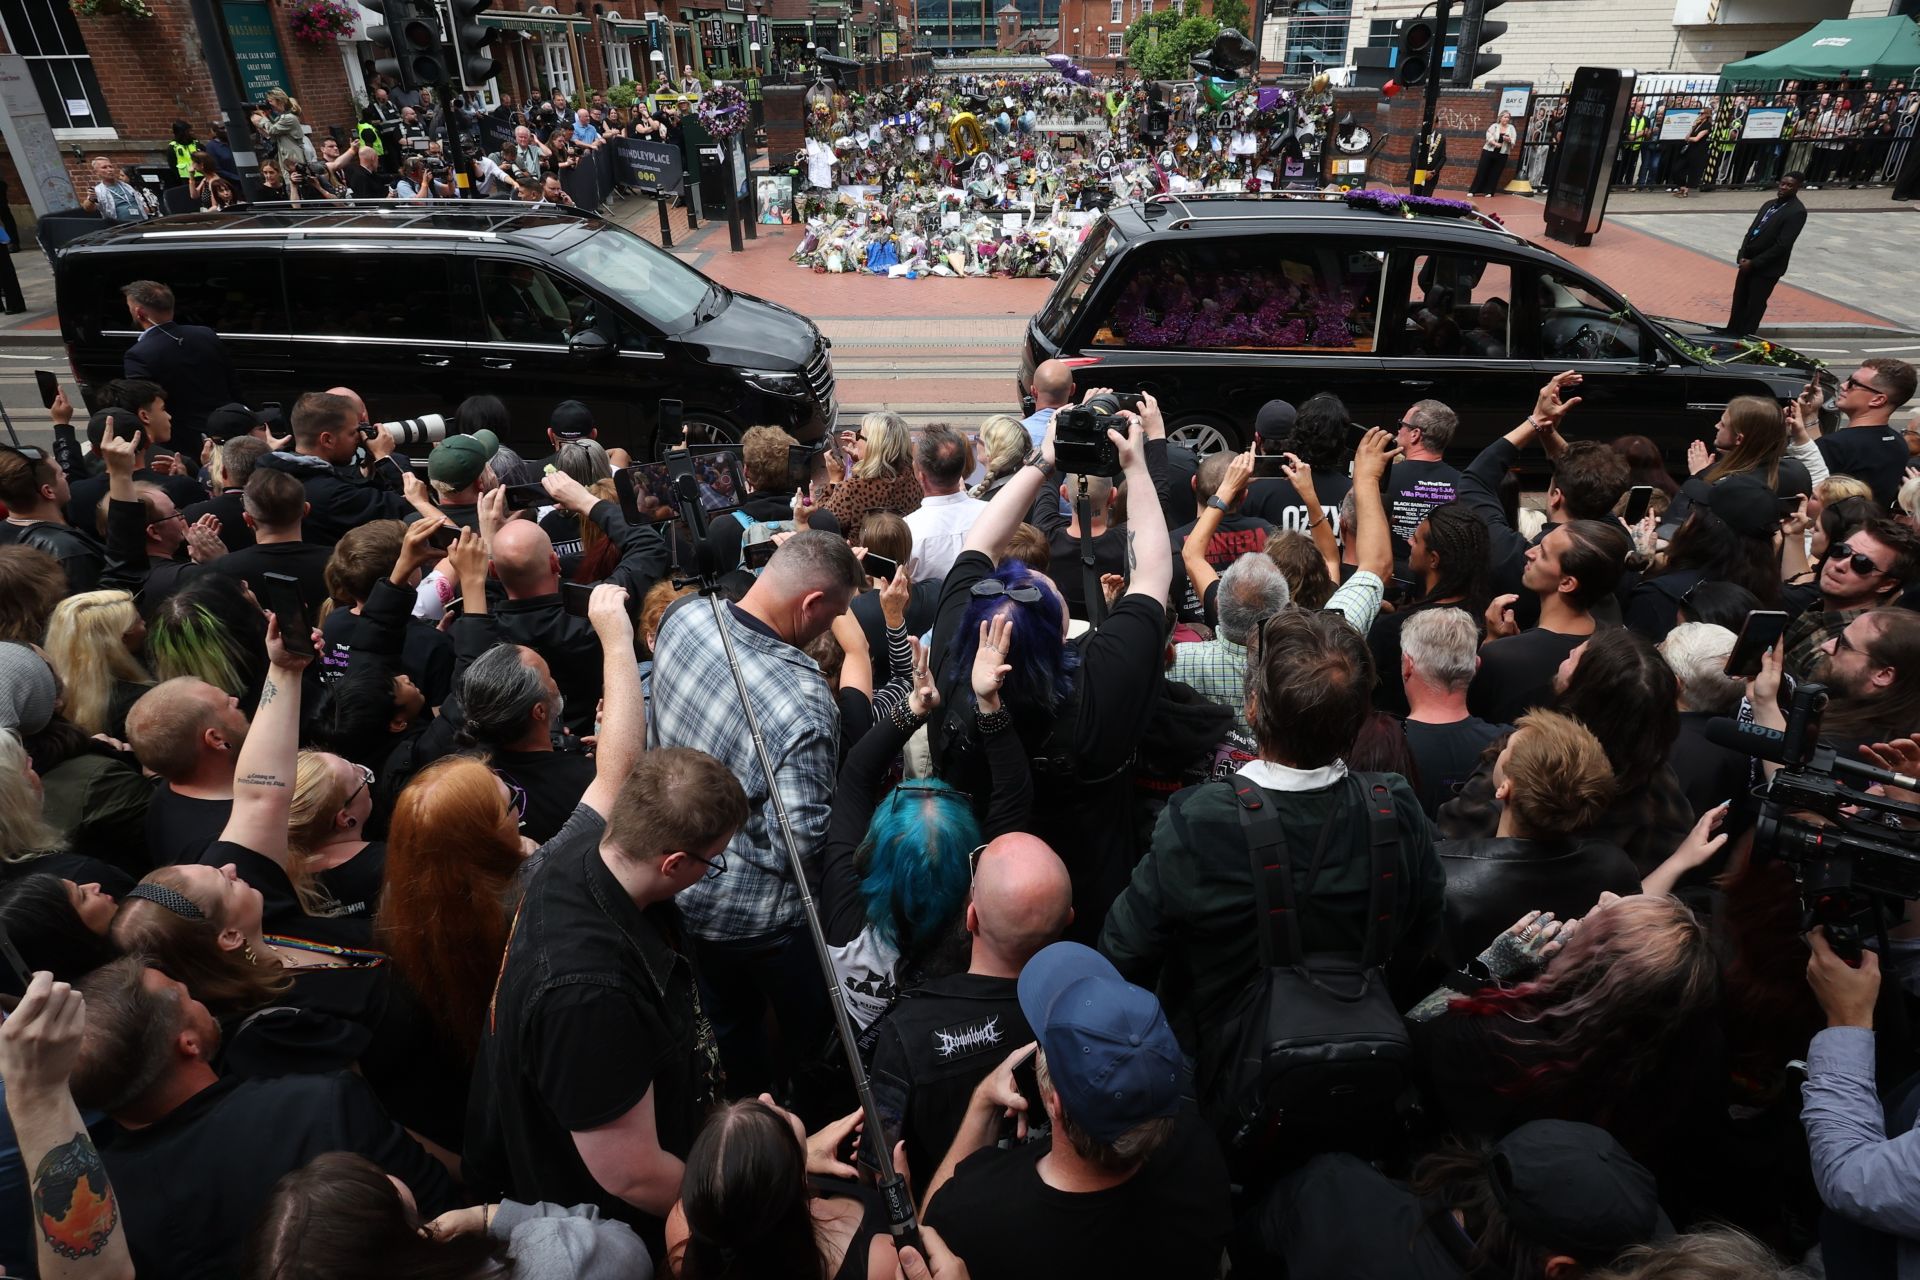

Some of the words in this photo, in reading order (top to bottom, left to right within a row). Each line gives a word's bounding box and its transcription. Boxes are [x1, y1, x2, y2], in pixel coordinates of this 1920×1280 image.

[236, 52, 248, 60] OCAL
[618, 147, 671, 165] BRINDLEYPLACE
[1414, 485, 1439, 493] Saturday
[1443, 486, 1455, 494] July
[1184, 528, 1269, 555] ANTERA
[1737, 722, 1785, 742] RØD
